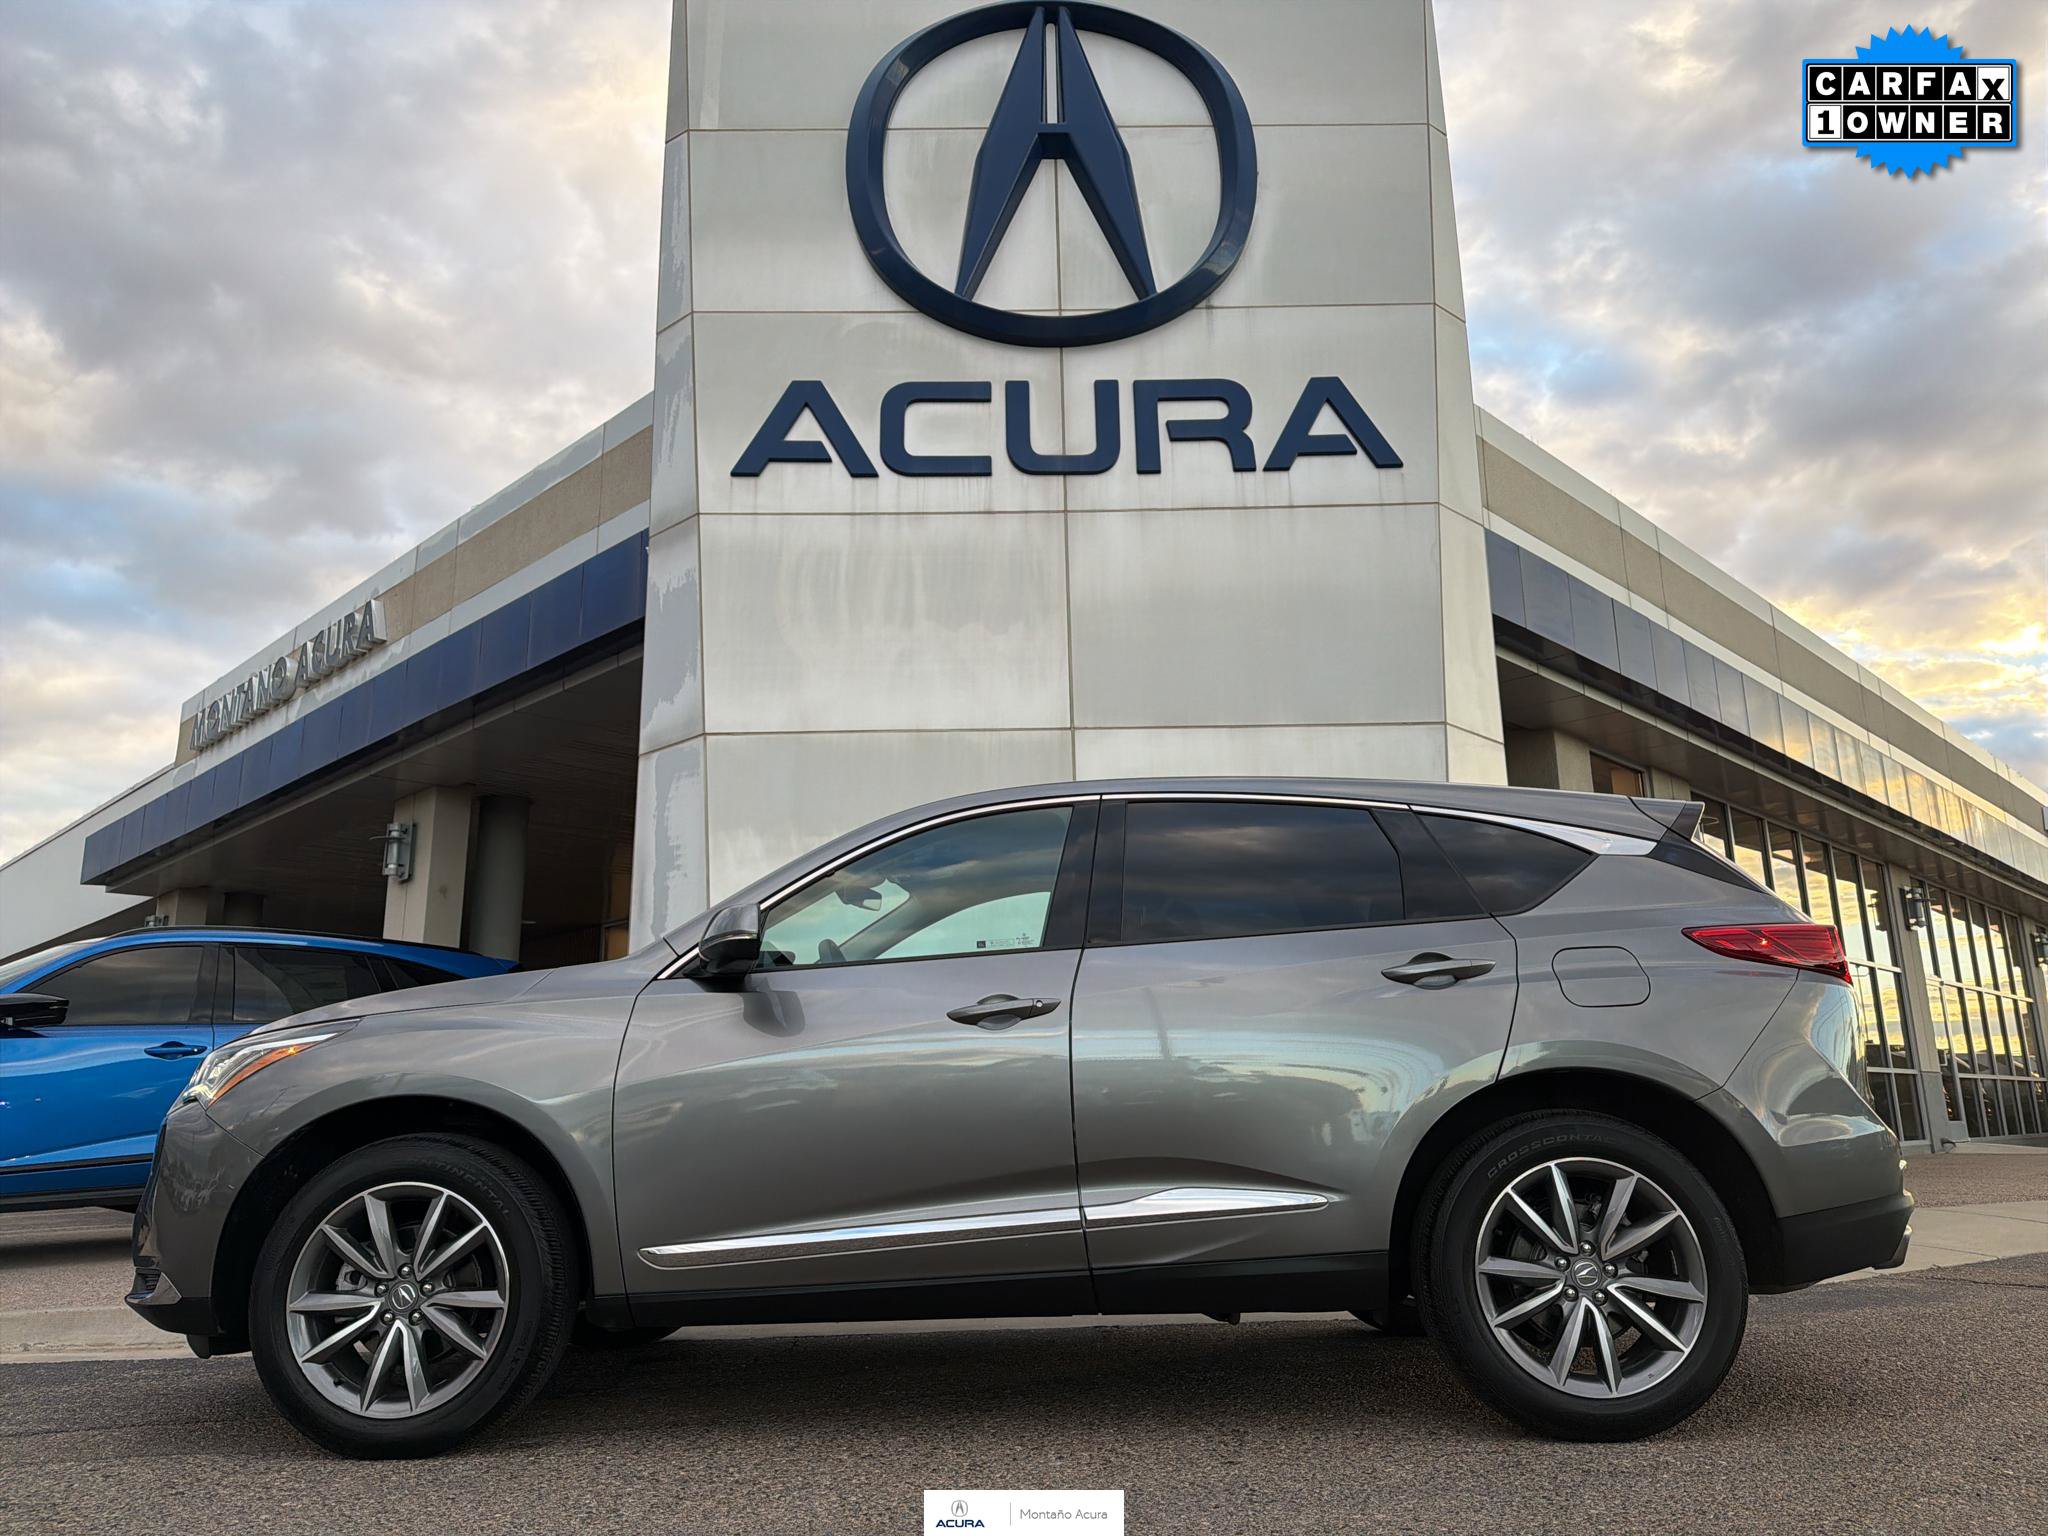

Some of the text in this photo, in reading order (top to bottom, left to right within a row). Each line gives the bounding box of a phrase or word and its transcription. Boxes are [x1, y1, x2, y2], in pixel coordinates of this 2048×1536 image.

[730, 376, 1404, 478] ACURA
[295, 599, 387, 689] ACURA
[1487, 1134, 1617, 1178] CROSSCONTAC
